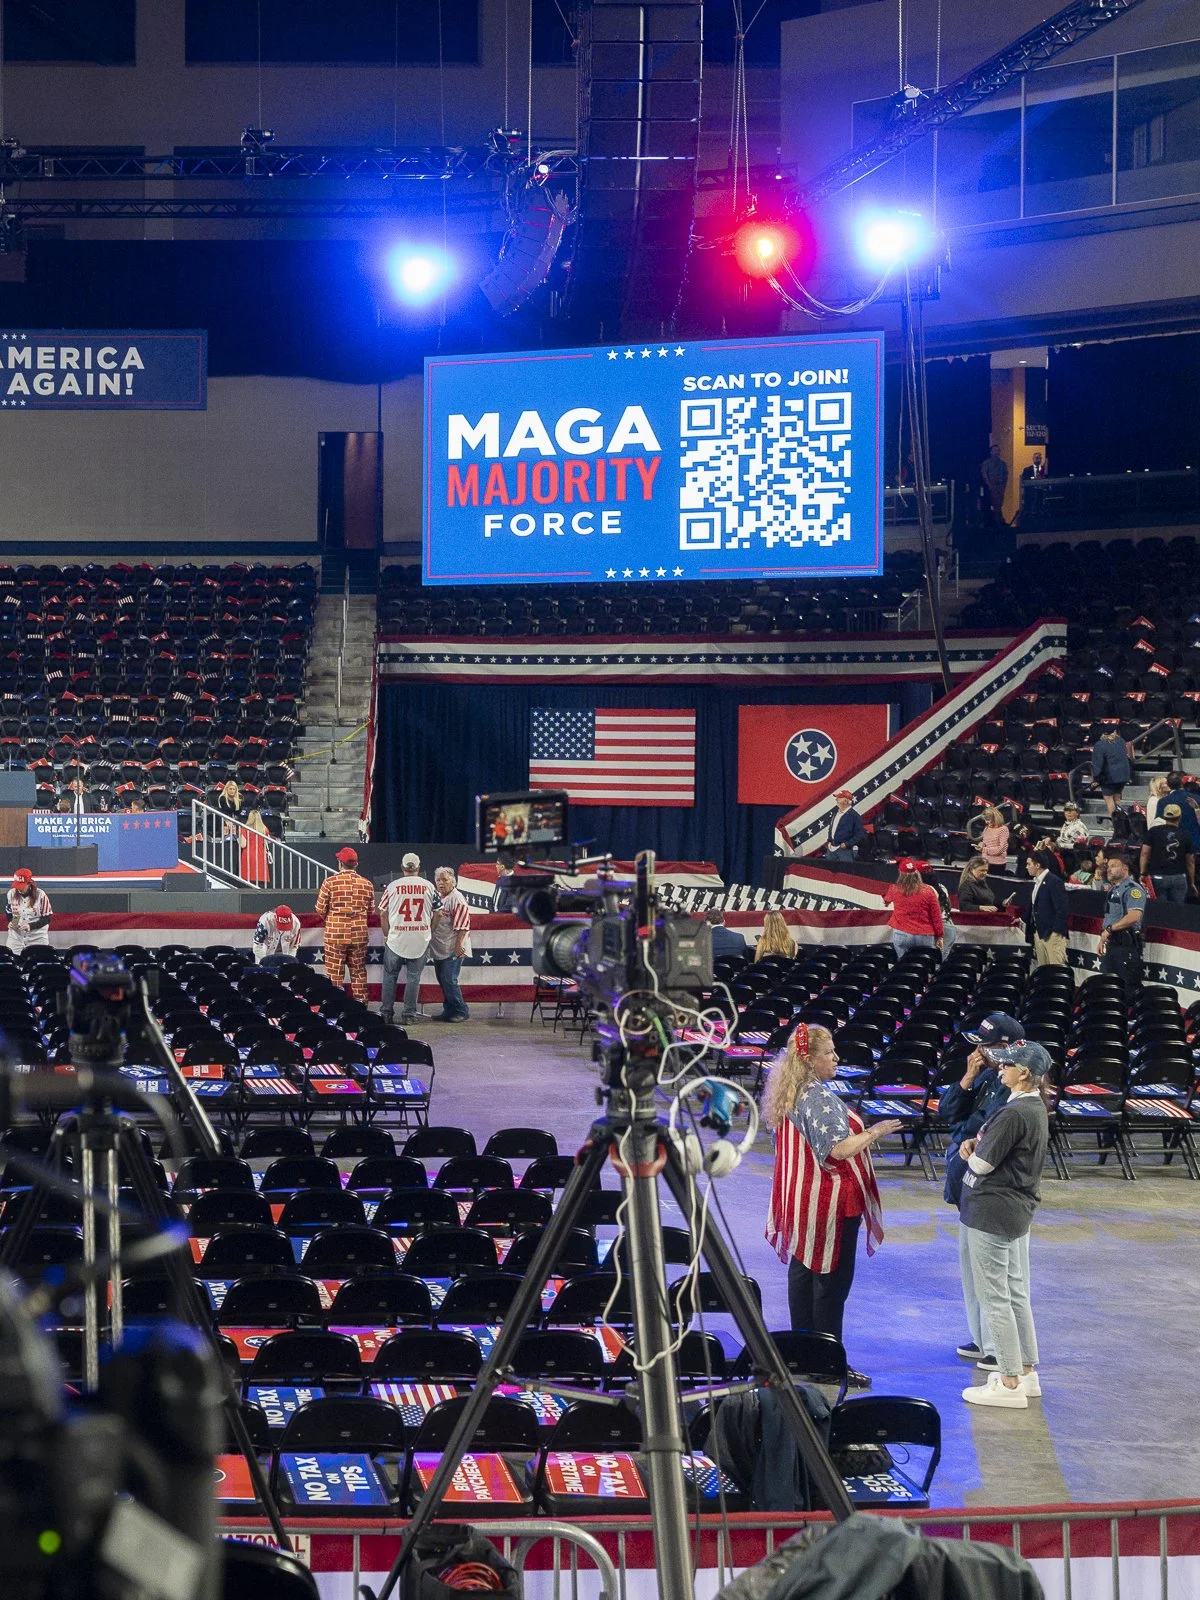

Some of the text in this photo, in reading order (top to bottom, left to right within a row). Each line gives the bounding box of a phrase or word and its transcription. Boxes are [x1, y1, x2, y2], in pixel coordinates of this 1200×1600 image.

[6, 372, 134, 395] AGAIN!
[683, 368, 848, 392] SCAN TO JOIN!
[447, 405, 662, 460] MAGA
[447, 457, 661, 507] MAJORITY
[484, 510, 622, 537] FORCE
[37, 825, 109, 833] GREAT AGAIN!
[396, 885, 427, 895] TRUMP
[399, 898, 425, 922] 47
[256, 1388, 286, 1425] NO TAX
[283, 1401, 297, 1412] ON
[295, 1456, 332, 1501] NO TAX
[325, 1472, 342, 1484] ON
[340, 1465, 370, 1492] TIPS
[555, 1453, 584, 1493] VERTIME
[581, 1465, 597, 1477] ON
[593, 1454, 629, 1495] NO TAX
